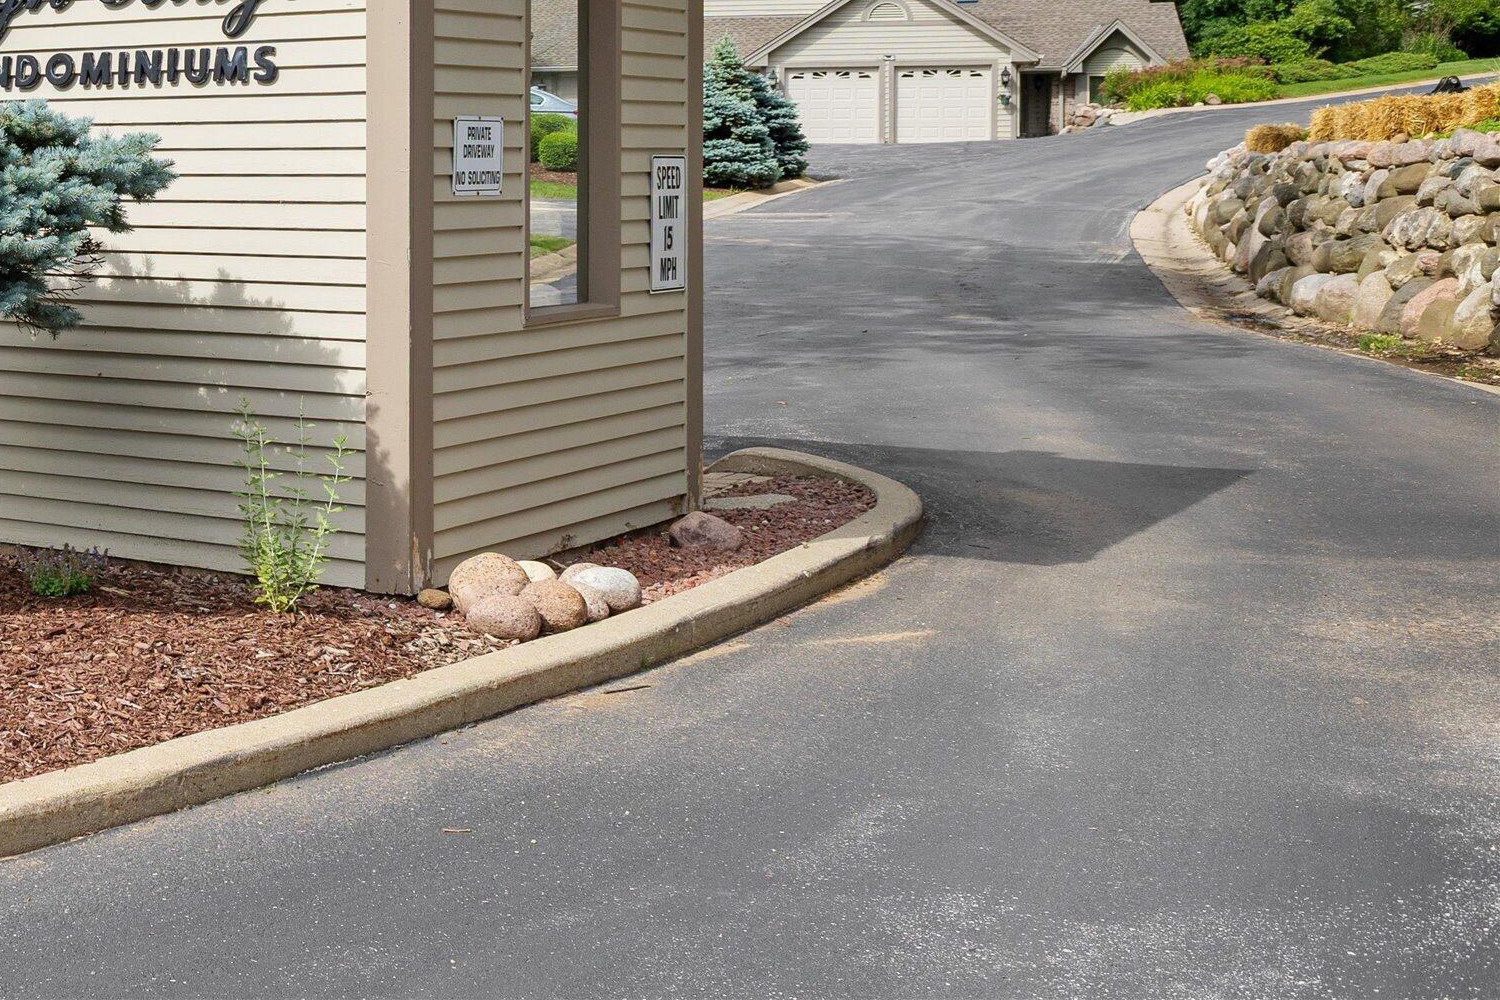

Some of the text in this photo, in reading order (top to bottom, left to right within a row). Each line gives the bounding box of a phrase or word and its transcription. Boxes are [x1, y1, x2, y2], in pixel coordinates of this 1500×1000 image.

[467, 126, 492, 140] PRIVATE
[463, 144, 495, 158] DRIVEWAY
[456, 171, 500, 185] NO SOLICITING
[656, 166, 680, 190] SPEED
[658, 195, 679, 219] LIMIT
[664, 226, 673, 251] 15
[660, 257, 677, 281] MPH
